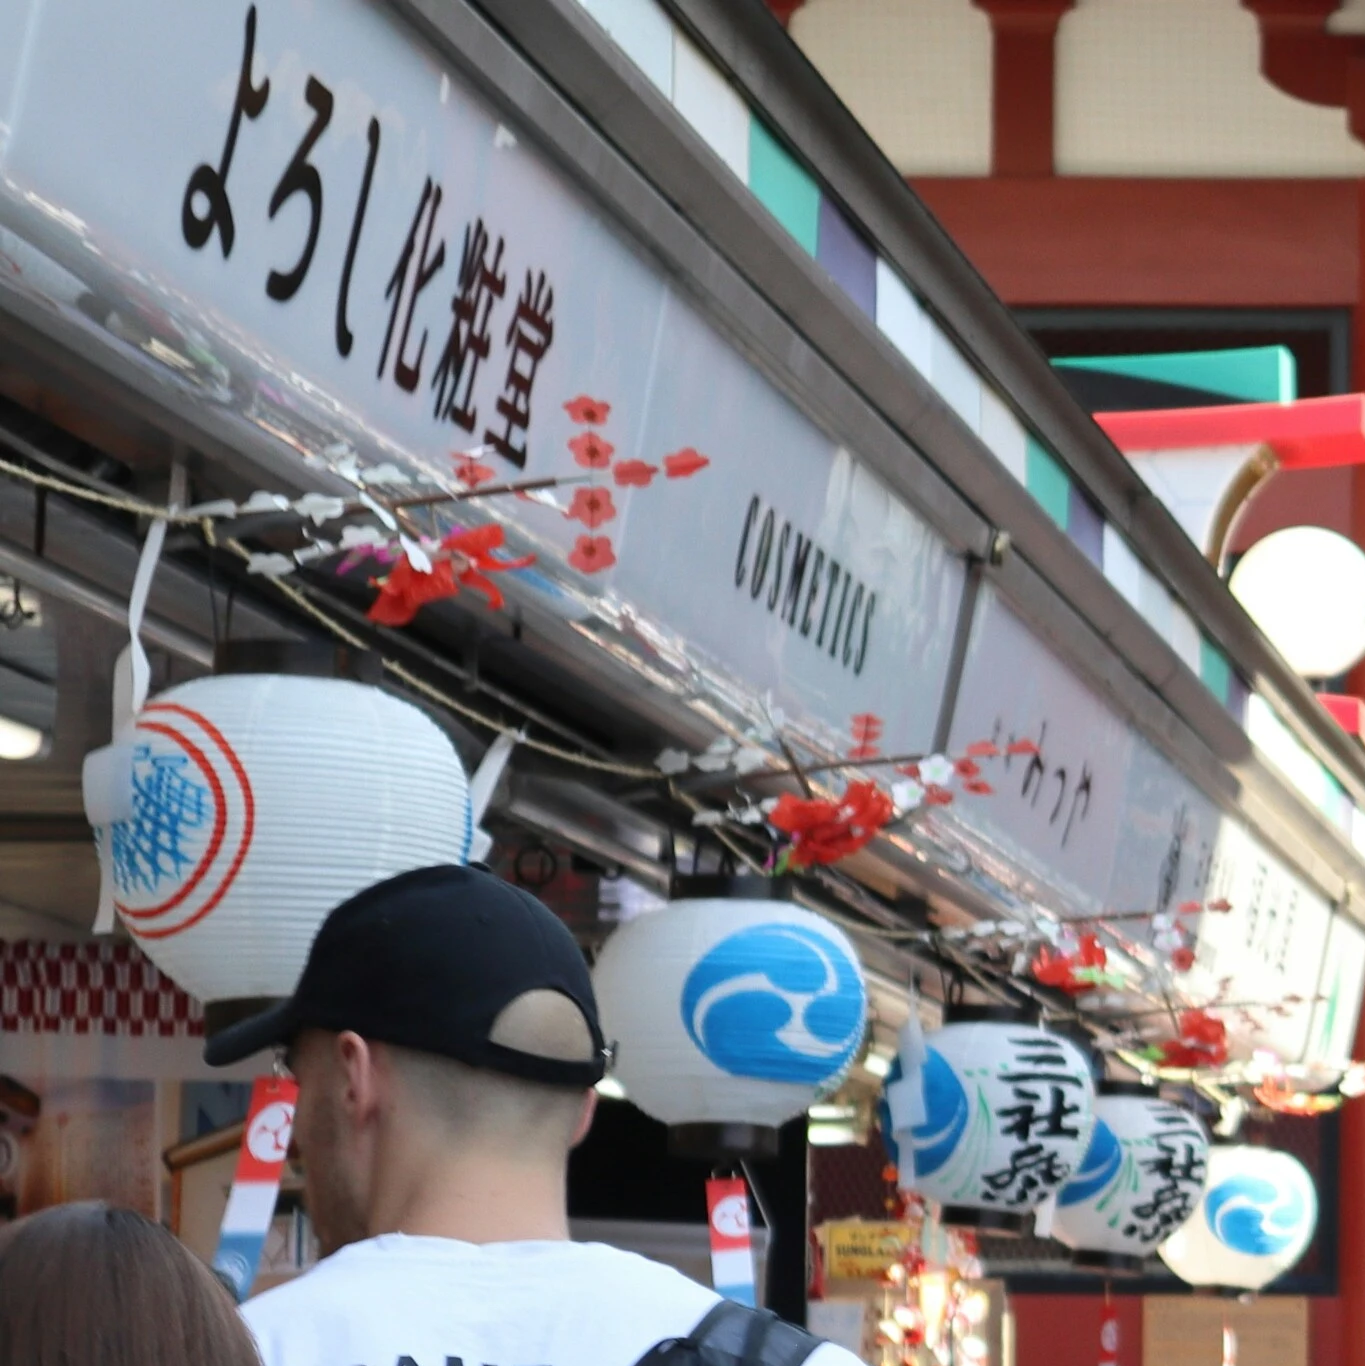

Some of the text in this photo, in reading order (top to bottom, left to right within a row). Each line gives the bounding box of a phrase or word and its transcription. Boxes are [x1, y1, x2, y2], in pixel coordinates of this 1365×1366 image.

[180, 3, 556, 470] よろし化粧堂
[734, 494, 877, 677] COSMETICS
